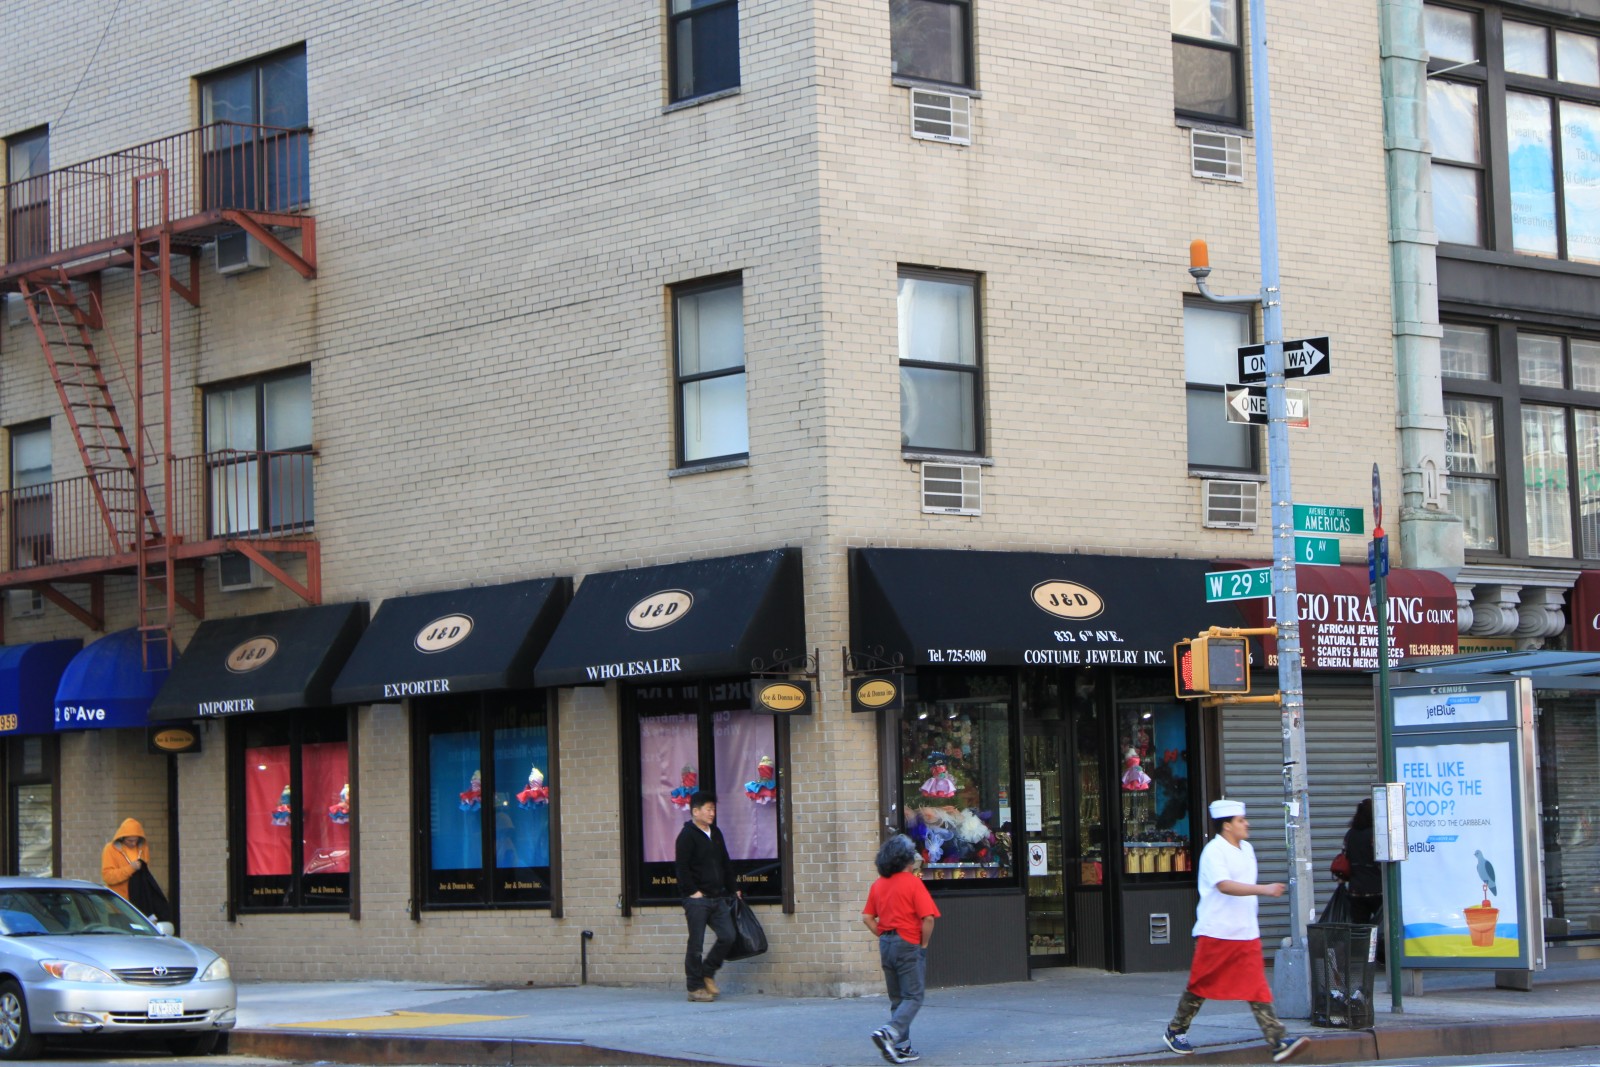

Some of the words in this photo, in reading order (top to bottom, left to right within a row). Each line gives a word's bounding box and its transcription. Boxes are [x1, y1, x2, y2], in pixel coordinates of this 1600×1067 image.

[1561, 124, 1583, 139] oga
[1576, 148, 1589, 160] Tai
[1511, 202, 1533, 213] ower
[1513, 213, 1554, 231] Breathing
[1251, 357, 1265, 371] ON
[1288, 350, 1315, 367] WAY
[1242, 398, 1266, 412] ONE
[1309, 507, 1327, 516] AVENUE
[1329, 509, 1335, 517] OF
[1337, 508, 1346, 517] THE
[1305, 516, 1351, 532] AMERICAS
[1305, 540, 1314, 561] 6
[1318, 540, 1326, 551] AV
[1210, 576, 1223, 598] W
[1231, 573, 1252, 596] 29
[1259, 572, 1269, 584] ST
[1334, 595, 1424, 624] TRAING
[1054, 631, 1075, 642] 832
[1096, 631, 1124, 642] AVE.
[1318, 624, 1355, 635] AFRICAN
[1357, 625, 1395, 636] JEWERY
[1318, 635, 1356, 646] NATURAL
[1359, 636, 1396, 647] JEWERY
[928, 649, 944, 661] Tel.
[946, 649, 987, 662] 725-5080
[1024, 649, 1080, 664] COSTUME
[1085, 650, 1138, 664] JEWELRY
[1144, 650, 1166, 664] INC.
[1318, 647, 1351, 657] SCARVES
[1353, 647, 1359, 657] &
[1361, 647, 1378, 658] HAIR
[586, 657, 681, 680] WHOLESALER
[1317, 657, 1351, 668] GENERAL
[384, 679, 449, 697] EXPORTER
[1438, 686, 1467, 694] CEMUSA
[77, 706, 105, 721] Ave
[199, 698, 255, 716] IMPORTER
[1426, 704, 1456, 719] jetBlue
[1404, 762, 1432, 778] FEEL
[1438, 761, 1465, 777] LIKE
[1406, 780, 1453, 797] FLYING
[1458, 779, 1482, 796] THE
[1406, 800, 1455, 816] COOP?
[1438, 819, 1446, 827] TO
[1408, 842, 1435, 855] jetBlue
